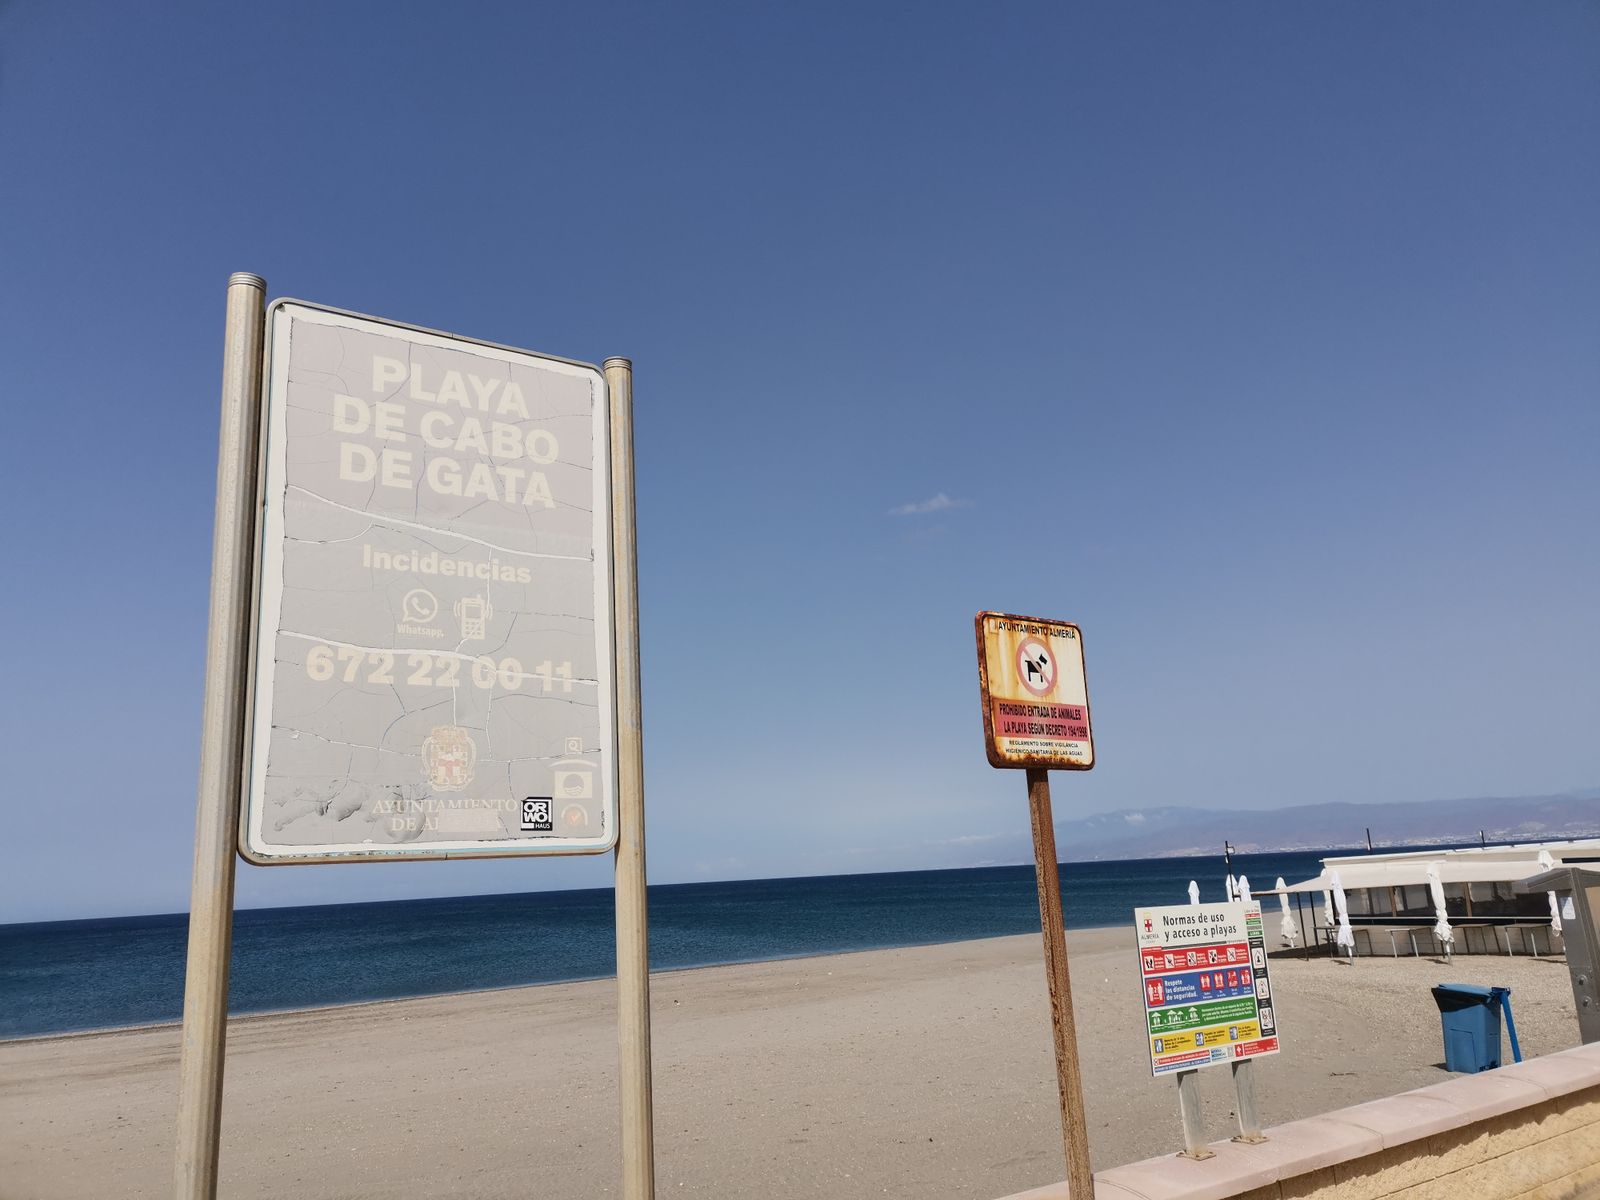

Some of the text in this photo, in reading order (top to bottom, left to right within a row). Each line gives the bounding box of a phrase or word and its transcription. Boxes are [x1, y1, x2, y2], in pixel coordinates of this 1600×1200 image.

[372, 355, 530, 419] PLAYA
[333, 394, 560, 465] DE CABO
[339, 442, 557, 508] DE GATA
[363, 544, 532, 583] Incidencias
[999, 621, 1048, 636] AYUNTAMIENTO
[307, 645, 573, 693] 672 22 00 11
[999, 703, 1082, 720] PROHIBIDO ENTRADA DE ANIMALES
[1004, 721, 1010, 733] LA
[1012, 722, 1028, 734] PLAYA
[1046, 723, 1067, 737] DECRETO
[392, 817, 417, 832] DE
[1163, 913, 1225, 926] Normas de uso
[1164, 931, 1170, 942] y
[1173, 927, 1201, 939] acceso
[1203, 927, 1208, 936] a
[1211, 925, 1237, 938] playas
